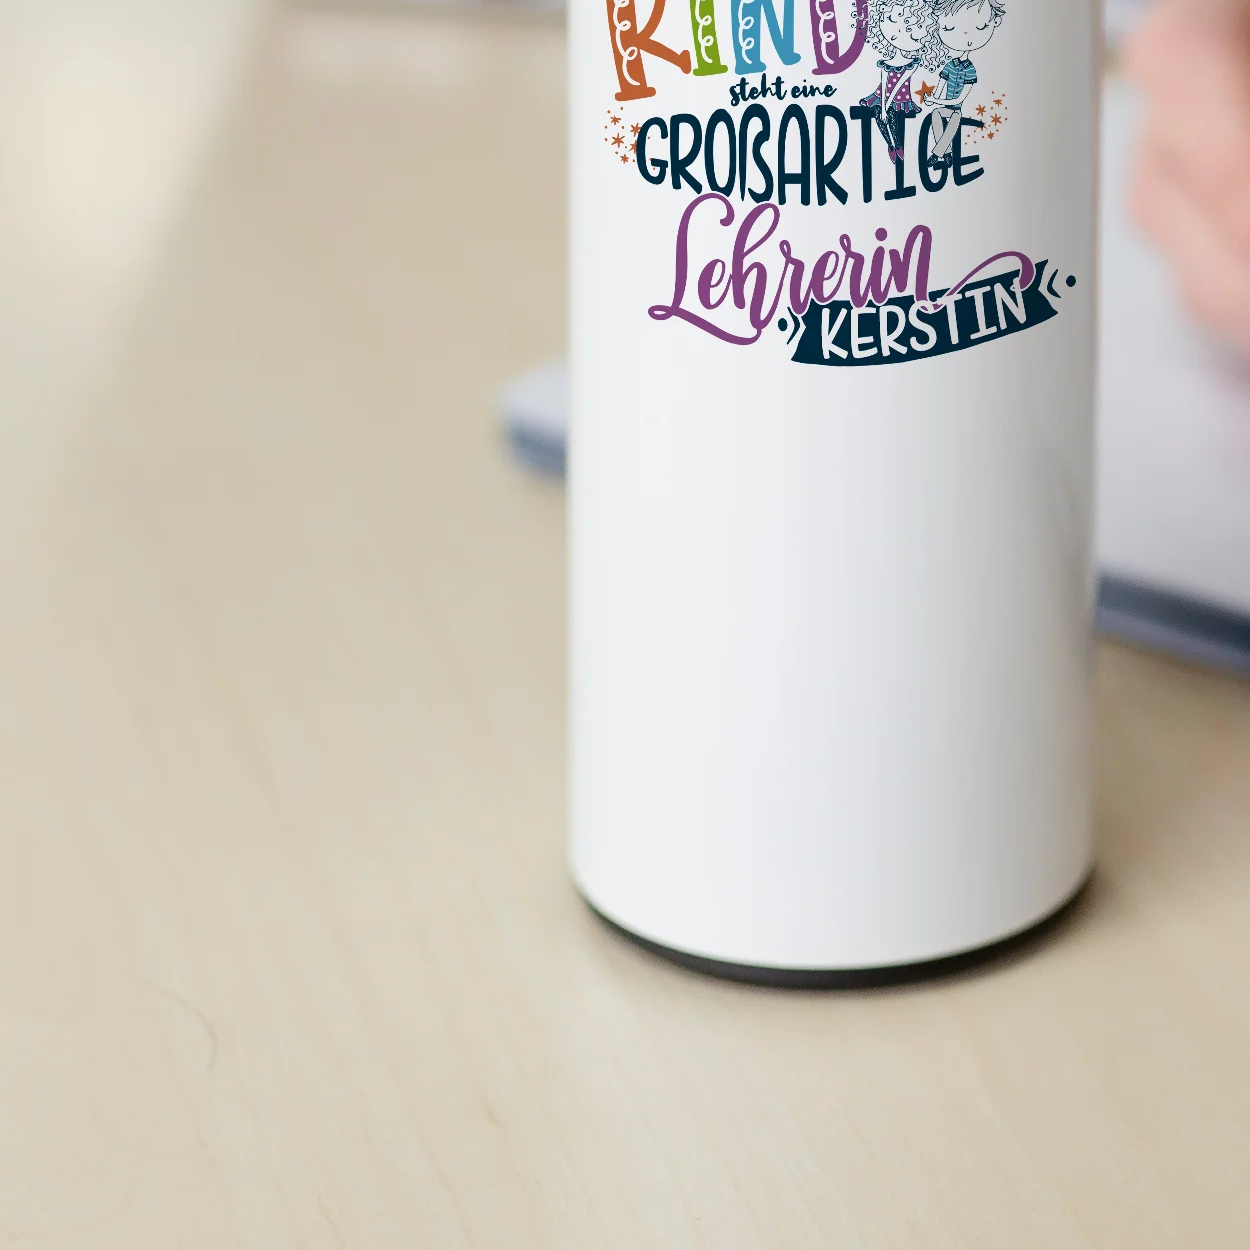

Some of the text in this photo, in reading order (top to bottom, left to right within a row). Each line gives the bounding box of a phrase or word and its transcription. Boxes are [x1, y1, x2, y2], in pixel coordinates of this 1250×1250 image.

[729, 72, 837, 107] steht eine
[648, 192, 1036, 346] Lehrerin
[821, 282, 1028, 359] KERSTIN
